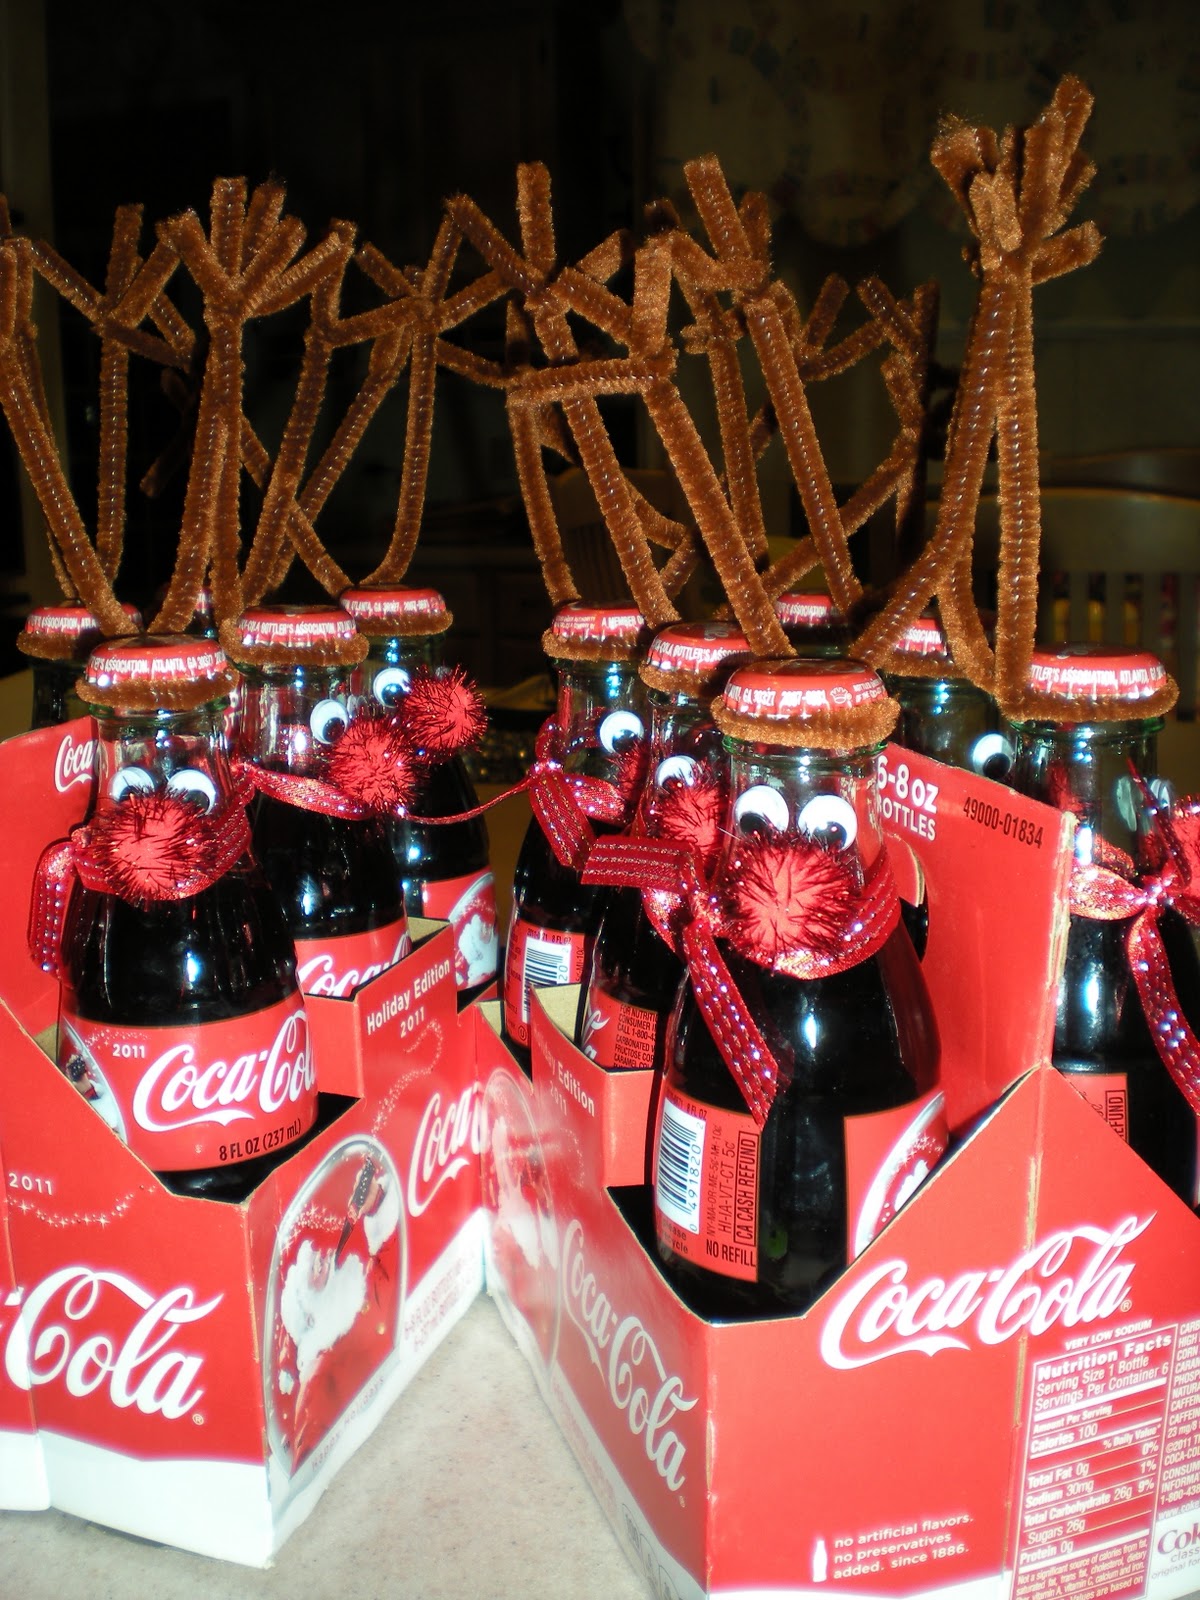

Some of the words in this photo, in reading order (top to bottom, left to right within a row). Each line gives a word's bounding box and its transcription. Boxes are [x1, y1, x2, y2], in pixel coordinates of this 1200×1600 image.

[911, 778, 939, 814] OZ
[963, 796, 1044, 850] 49000-01834
[366, 989, 411, 1036] Holiday
[413, 959, 450, 1000] Edition
[400, 1006, 426, 1039] 2011
[617, 1021, 631, 1036] CALL
[631, 1027, 656, 1042] 1-800-4
[619, 1013, 651, 1031] CONSUMER
[112, 1042, 146, 1059] 2011
[614, 1043, 641, 1060] FRUCTOSE
[616, 1033, 650, 1052] CARBONATED
[557, 1060, 595, 1118] Edition
[218, 1145, 228, 1161] 8
[230, 1142, 243, 1159] FL
[245, 1138, 260, 1156] OZ
[263, 1130, 284, 1151] (237
[285, 1118, 302, 1142] mL)
[738, 1138, 756, 1188] REFUND
[8, 1172, 52, 1196] 2011
[736, 1189, 755, 1222] CASH
[736, 1224, 754, 1240] CA
[706, 1238, 720, 1259] NO
[721, 1243, 757, 1268] REFILL
[820, 1210, 1157, 1370] Coca-Cola
[1065, 1337, 1089, 1351] VERY
[1091, 1331, 1113, 1344] LOW
[1115, 1320, 1153, 1338] SODIUM
[562, 1219, 699, 1492] Coca-Cola
[1038, 1350, 1118, 1382] Nutrition
[1124, 1334, 1172, 1358] Facts
[1035, 1391, 1084, 1412] Servings
[1087, 1382, 1105, 1398] Per
[1108, 1366, 1159, 1391] Container
[1161, 1361, 1169, 1376] 6
[1036, 1375, 1079, 1398] Serving
[1082, 1368, 1105, 1384] Size
[1118, 1355, 1150, 1375] Bottle
[1031, 1431, 1075, 1454] Calories
[1079, 1423, 1099, 1440] 100
[1033, 1417, 1065, 1435] Amount
[1066, 1412, 1080, 1425] Per
[1028, 1473, 1053, 1490] Total
[1055, 1466, 1073, 1482] Fat
[1076, 1462, 1091, 1477] 0g
[1142, 1440, 1159, 1456] 0%
[1025, 1488, 1064, 1508] Sodium
[1066, 1479, 1095, 1497] 30mg
[1140, 1461, 1157, 1475] 1%
[1023, 1511, 1047, 1528] Total
[1049, 1493, 1111, 1522] Carbohydrate
[1113, 1486, 1133, 1501] 26g
[1138, 1479, 1155, 1493] 9%
[834, 1537, 854, 1549] no
[857, 1523, 918, 1545] artificial
[922, 1514, 974, 1532] flavors.
[834, 1553, 853, 1564] no
[857, 1532, 952, 1562] preservatives
[1027, 1525, 1064, 1546] Sugars
[1066, 1518, 1086, 1534] 26g
[833, 1561, 885, 1580] added.
[891, 1552, 928, 1569] since
[932, 1543, 970, 1560] 1886.
[1019, 1544, 1057, 1565] Protein
[1060, 1540, 1075, 1554] 0g
